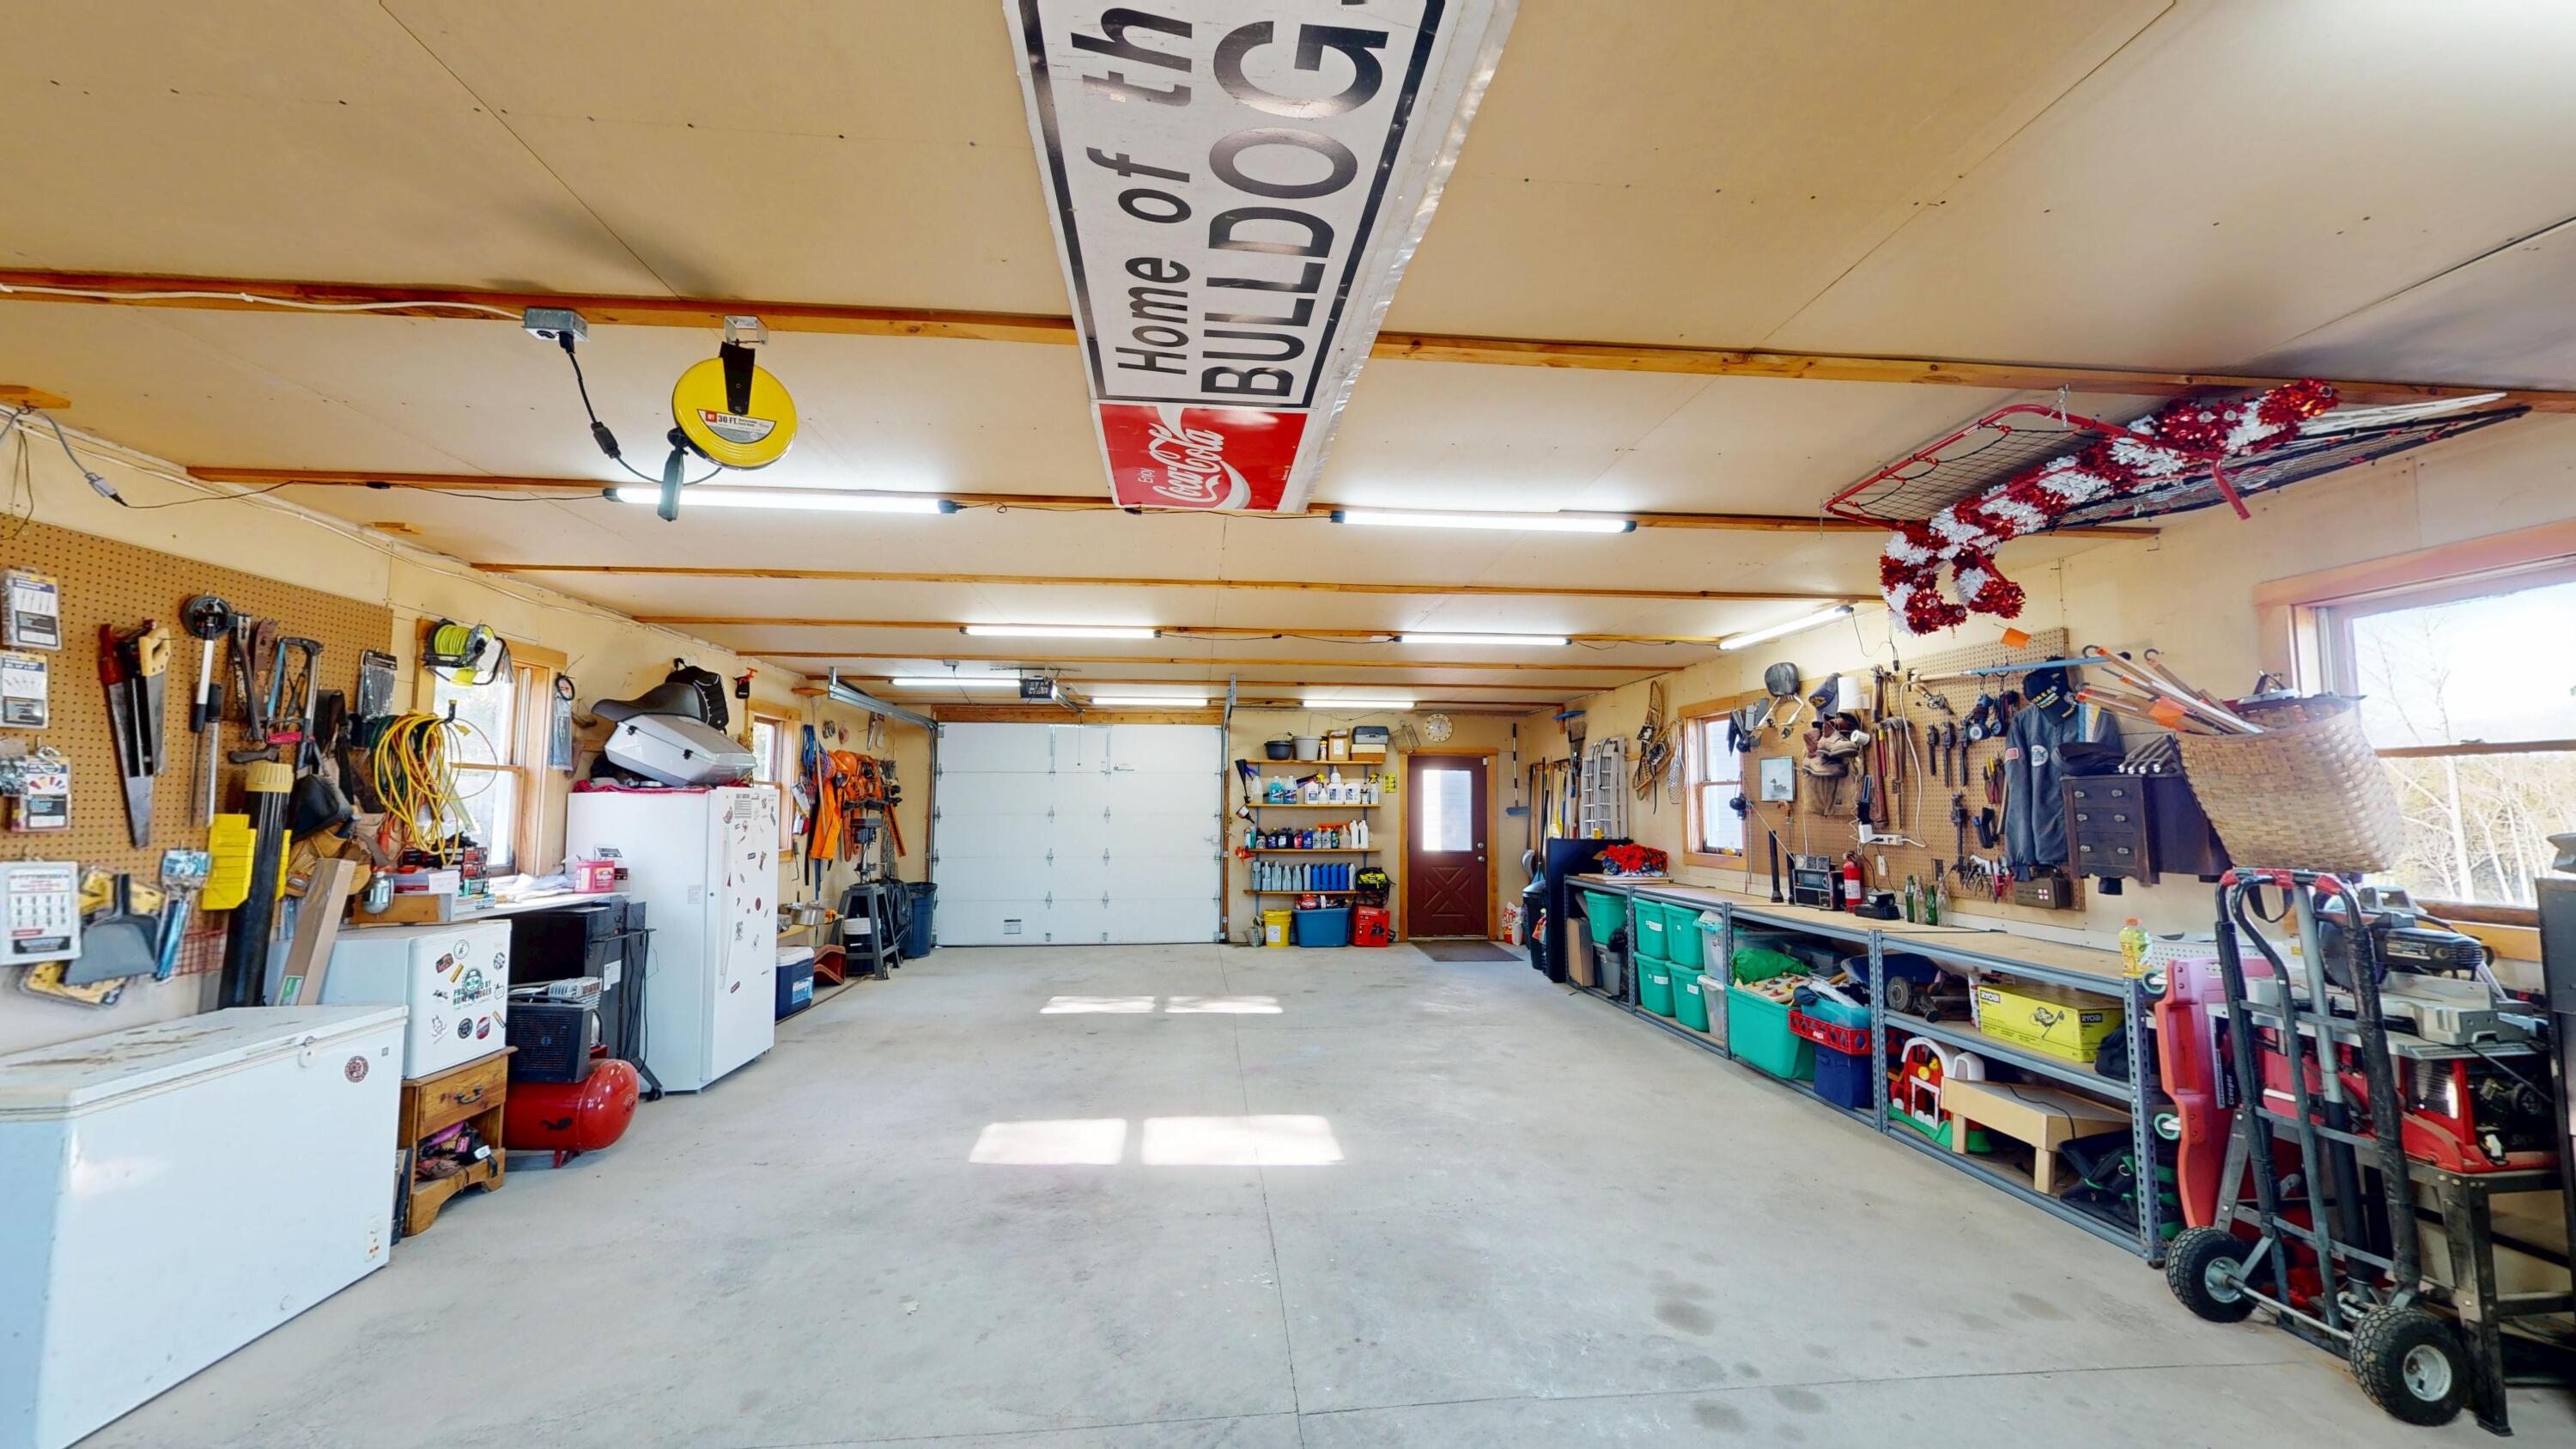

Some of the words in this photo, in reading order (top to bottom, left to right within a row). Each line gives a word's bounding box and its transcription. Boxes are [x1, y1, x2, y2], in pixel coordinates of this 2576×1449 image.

[1085, 146, 1192, 224] of
[1200, 0, 1389, 398] BULLDOG
[1115, 256, 1191, 375] Home
[1137, 467, 1156, 484] Enjoy
[1148, 422, 1225, 503] Coca-Cola
[1980, 990, 2000, 1003] RYOBI
[2226, 1074, 2235, 1105] Creeper
